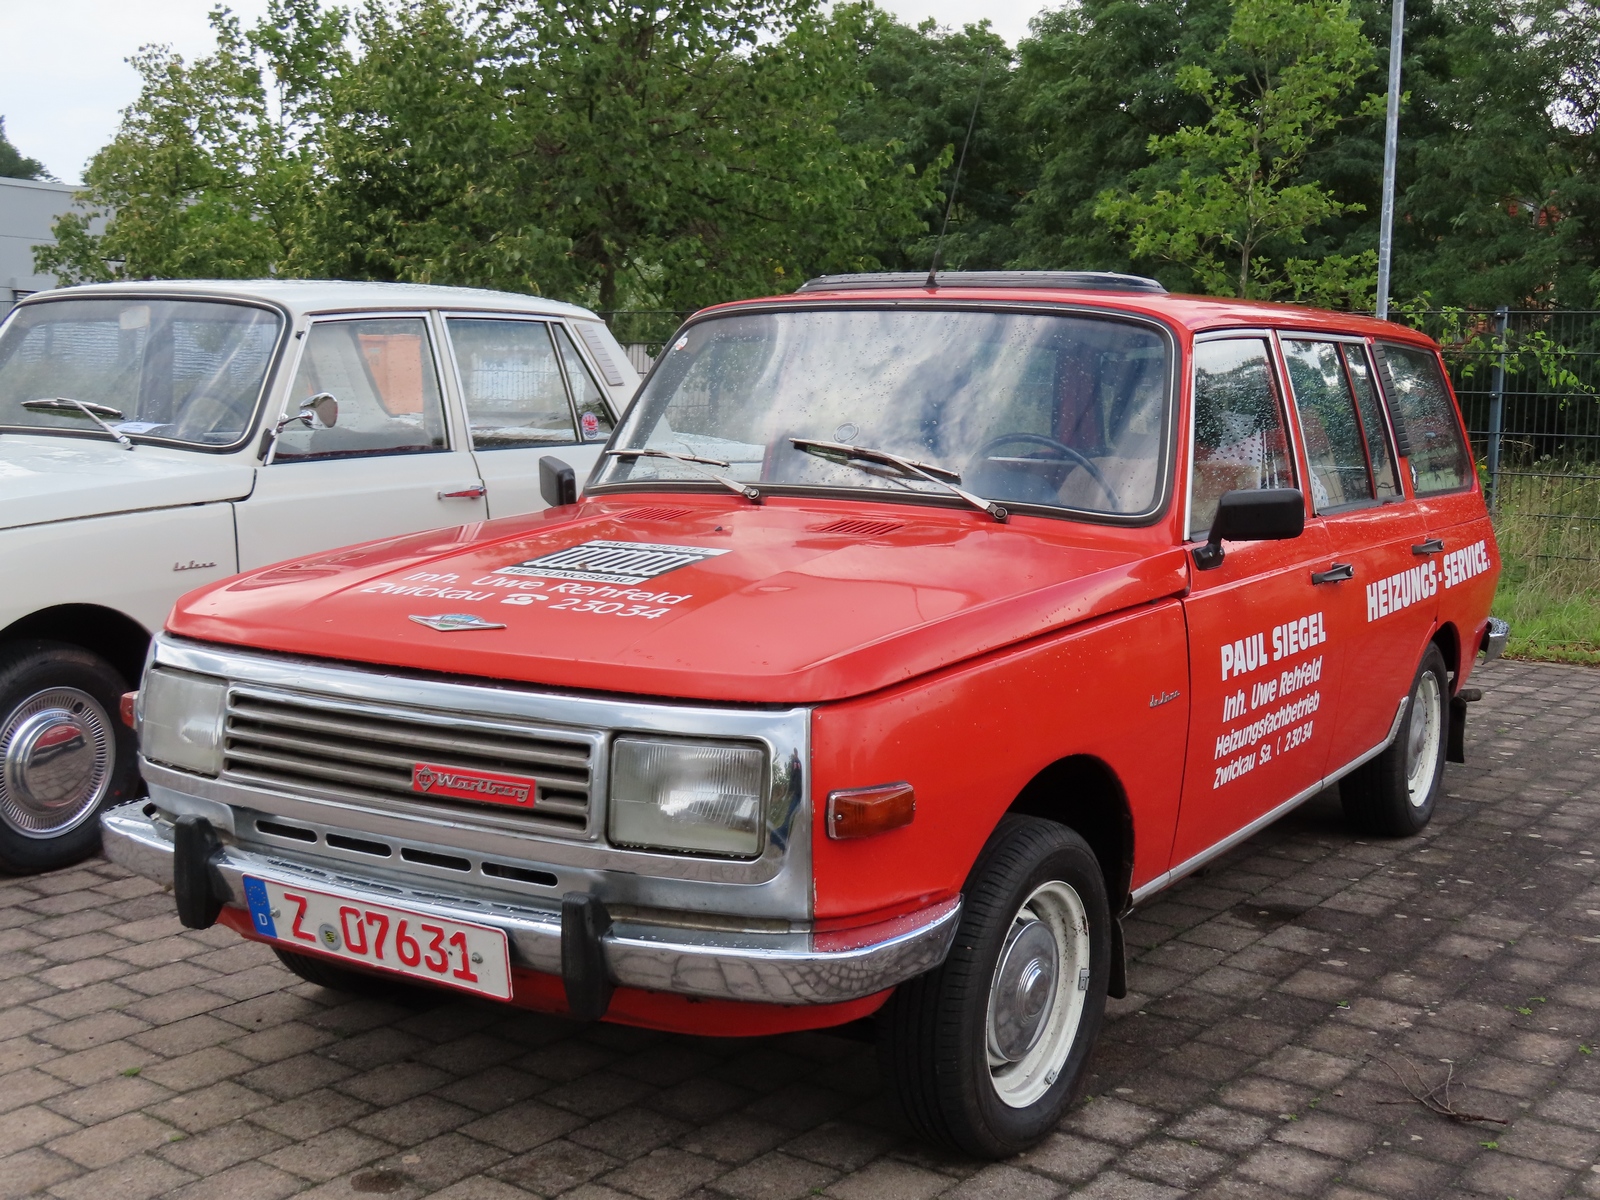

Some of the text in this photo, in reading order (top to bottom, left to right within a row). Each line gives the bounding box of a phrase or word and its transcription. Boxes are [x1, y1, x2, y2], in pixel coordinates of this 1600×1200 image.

[360, 582, 671, 619] Zwickau 23034
[402, 571, 692, 605] Inh. Uwe Rehfeld
[503, 567, 638, 584] HEIZUNGSBAU
[1221, 612, 1326, 681] PAUL SIEGEL
[1222, 655, 1323, 723] Inh. Uwe Rehfeld
[1214, 690, 1320, 760] Heizungsfachbetrieb
[1213, 752, 1256, 790] Zwickau
[1259, 744, 1272, 766] Sa.
[1284, 720, 1314, 753] 23034
[437, 772, 530, 803] Wartburg
[259, 913, 268, 926] D
[284, 893, 478, 983] Z 07631
